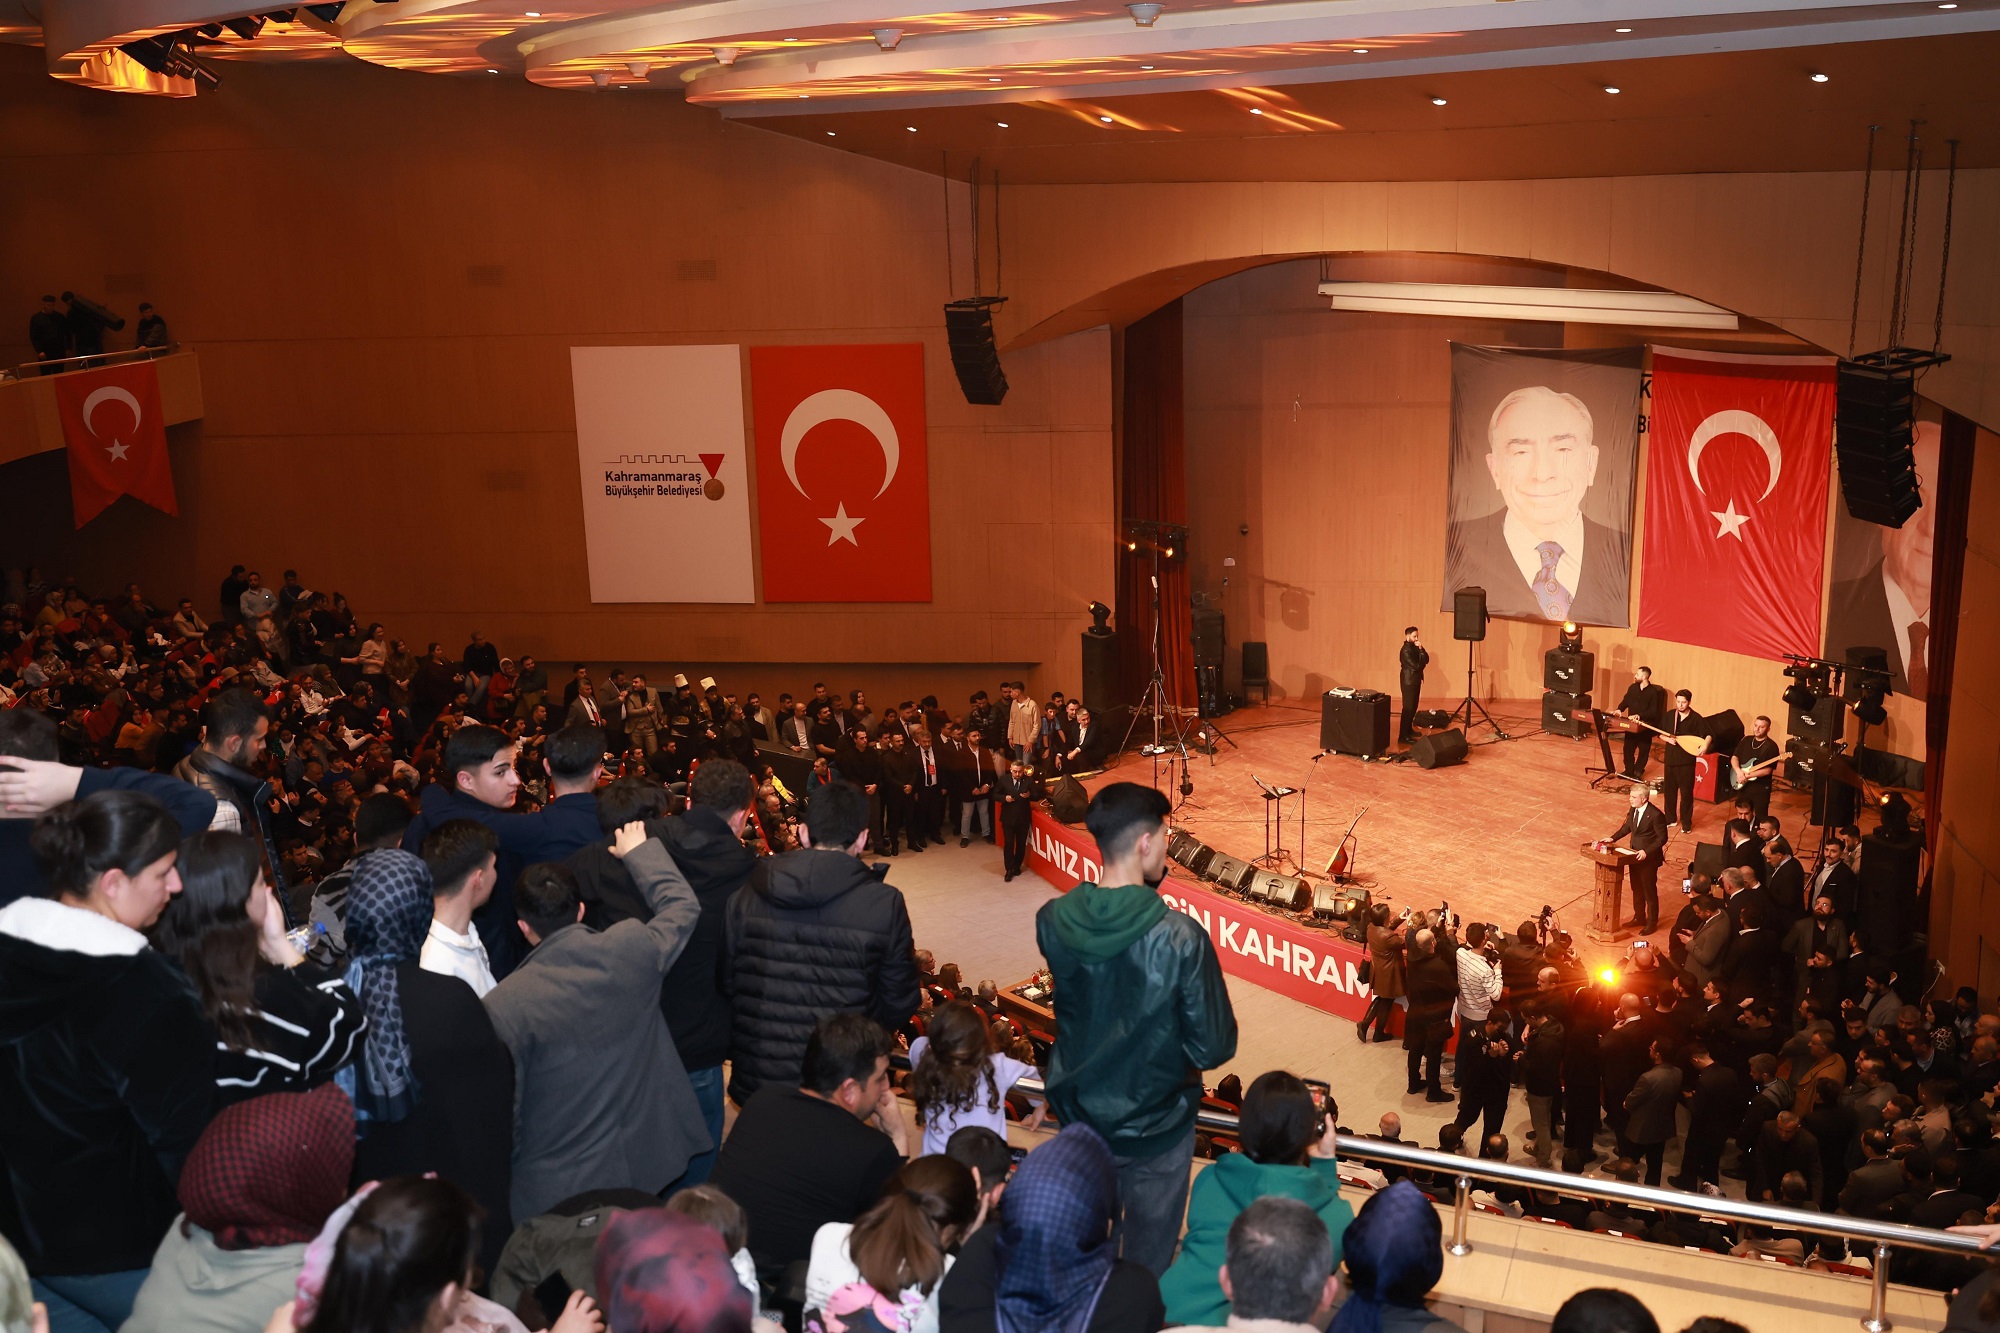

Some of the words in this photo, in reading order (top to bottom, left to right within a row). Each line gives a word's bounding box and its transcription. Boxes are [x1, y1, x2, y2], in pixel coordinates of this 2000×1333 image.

[605, 471, 702, 484] Kahramanmaraş
[605, 485, 655, 498] Büyükşehir
[656, 485, 702, 498] Belediyesi
[1026, 825, 1080, 881] ALNIZ
[1219, 915, 1379, 1002] KAHRAM
